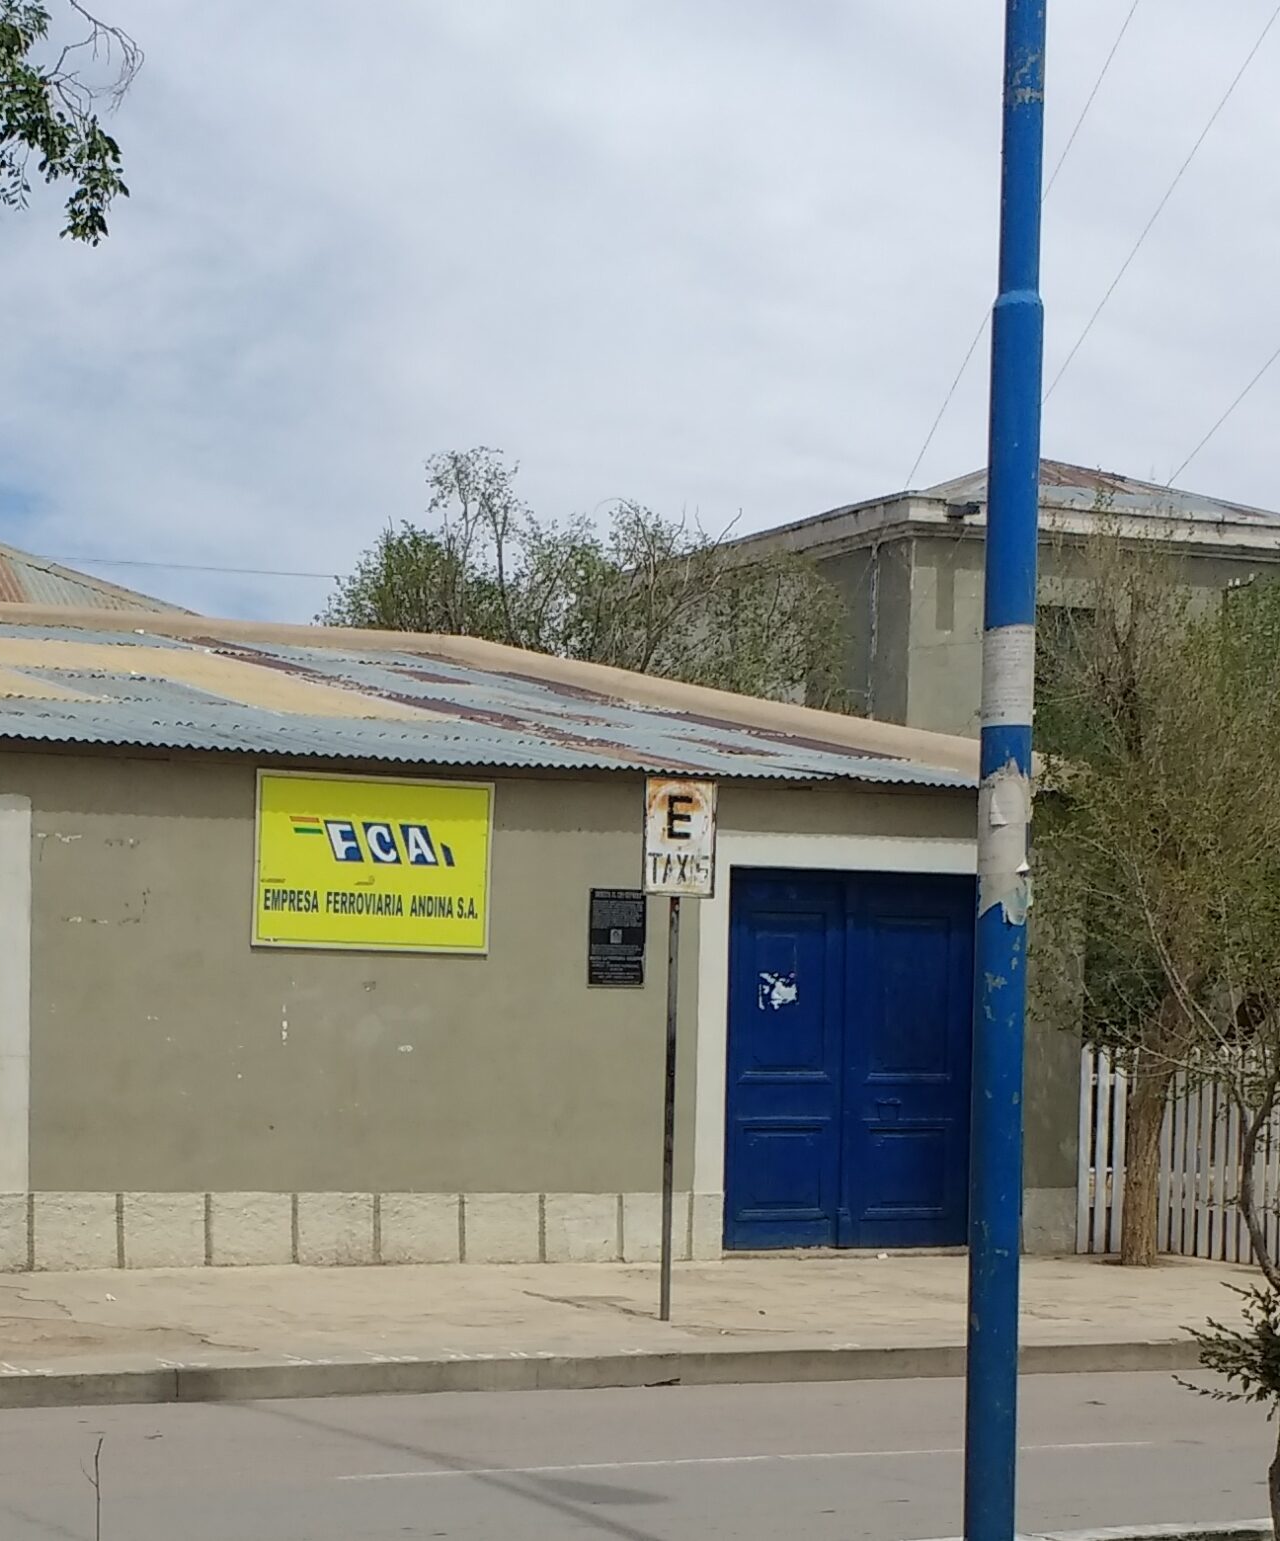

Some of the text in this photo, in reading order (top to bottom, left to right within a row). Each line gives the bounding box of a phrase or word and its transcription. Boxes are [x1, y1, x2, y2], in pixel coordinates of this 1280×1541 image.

[667, 795, 693, 840] E
[263, 888, 479, 919] EMPRESA FERROVIARIA ANDINA S.A.
